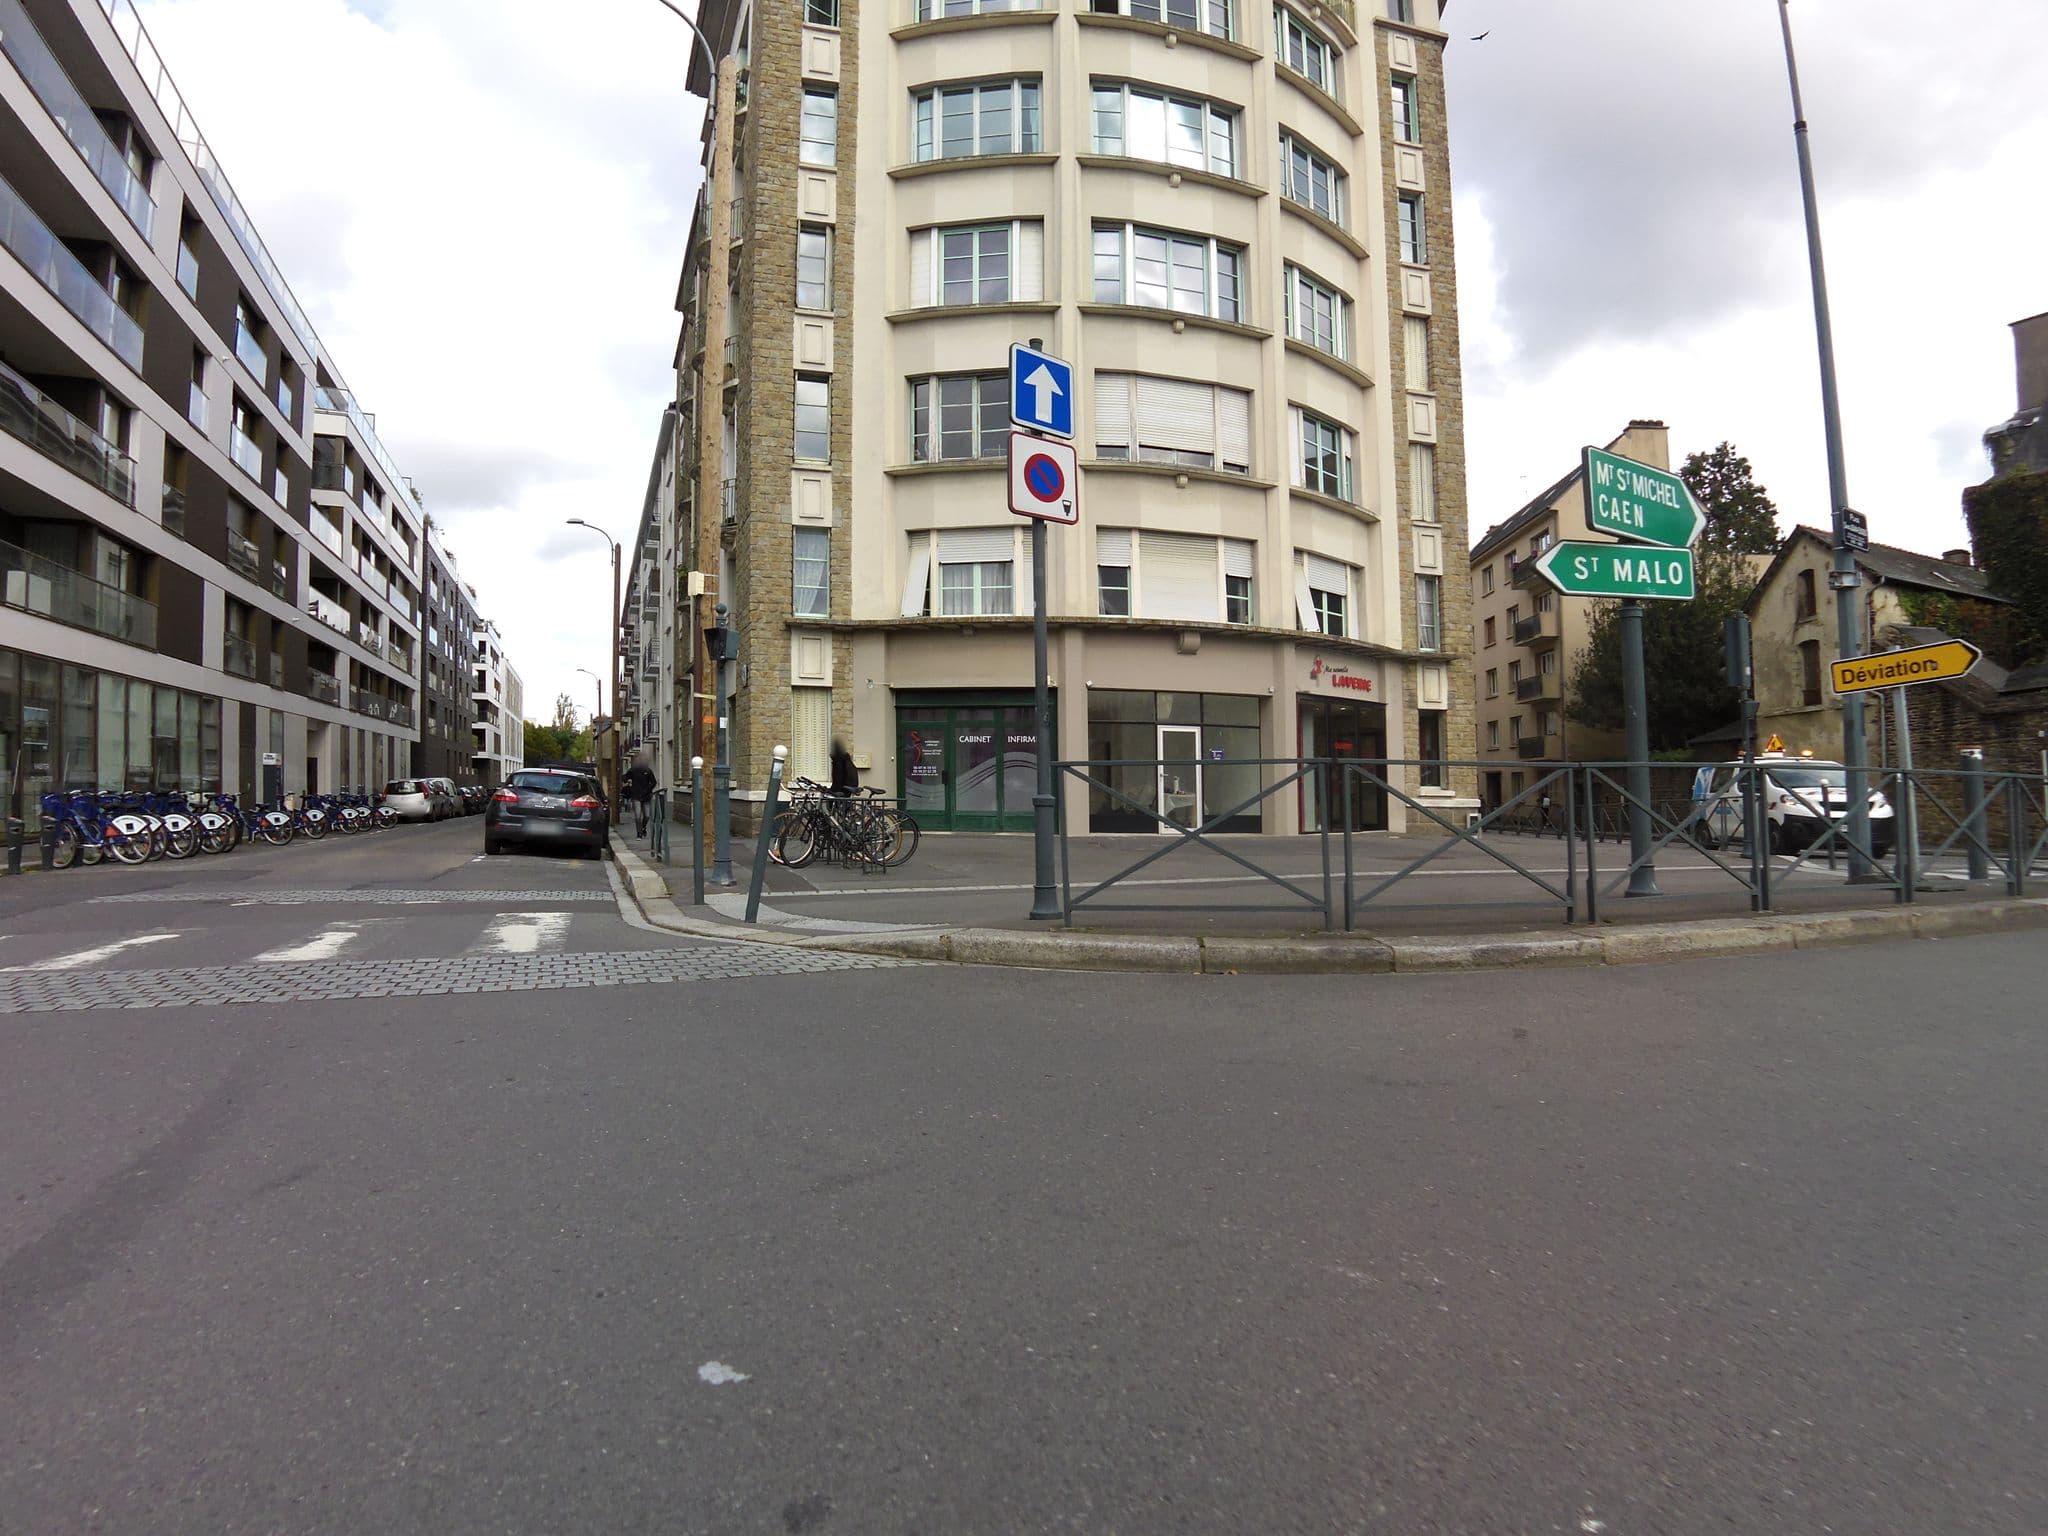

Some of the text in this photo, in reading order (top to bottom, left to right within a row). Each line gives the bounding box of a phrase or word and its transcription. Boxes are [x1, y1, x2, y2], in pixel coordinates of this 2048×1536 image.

[1632, 473, 1681, 509] MICHEL
[1598, 493, 1644, 528] CAEN
[1613, 558, 1684, 585] MALO
[1841, 659, 1939, 685] Déviation
[958, 735, 1037, 743] CABINET INFIRM
